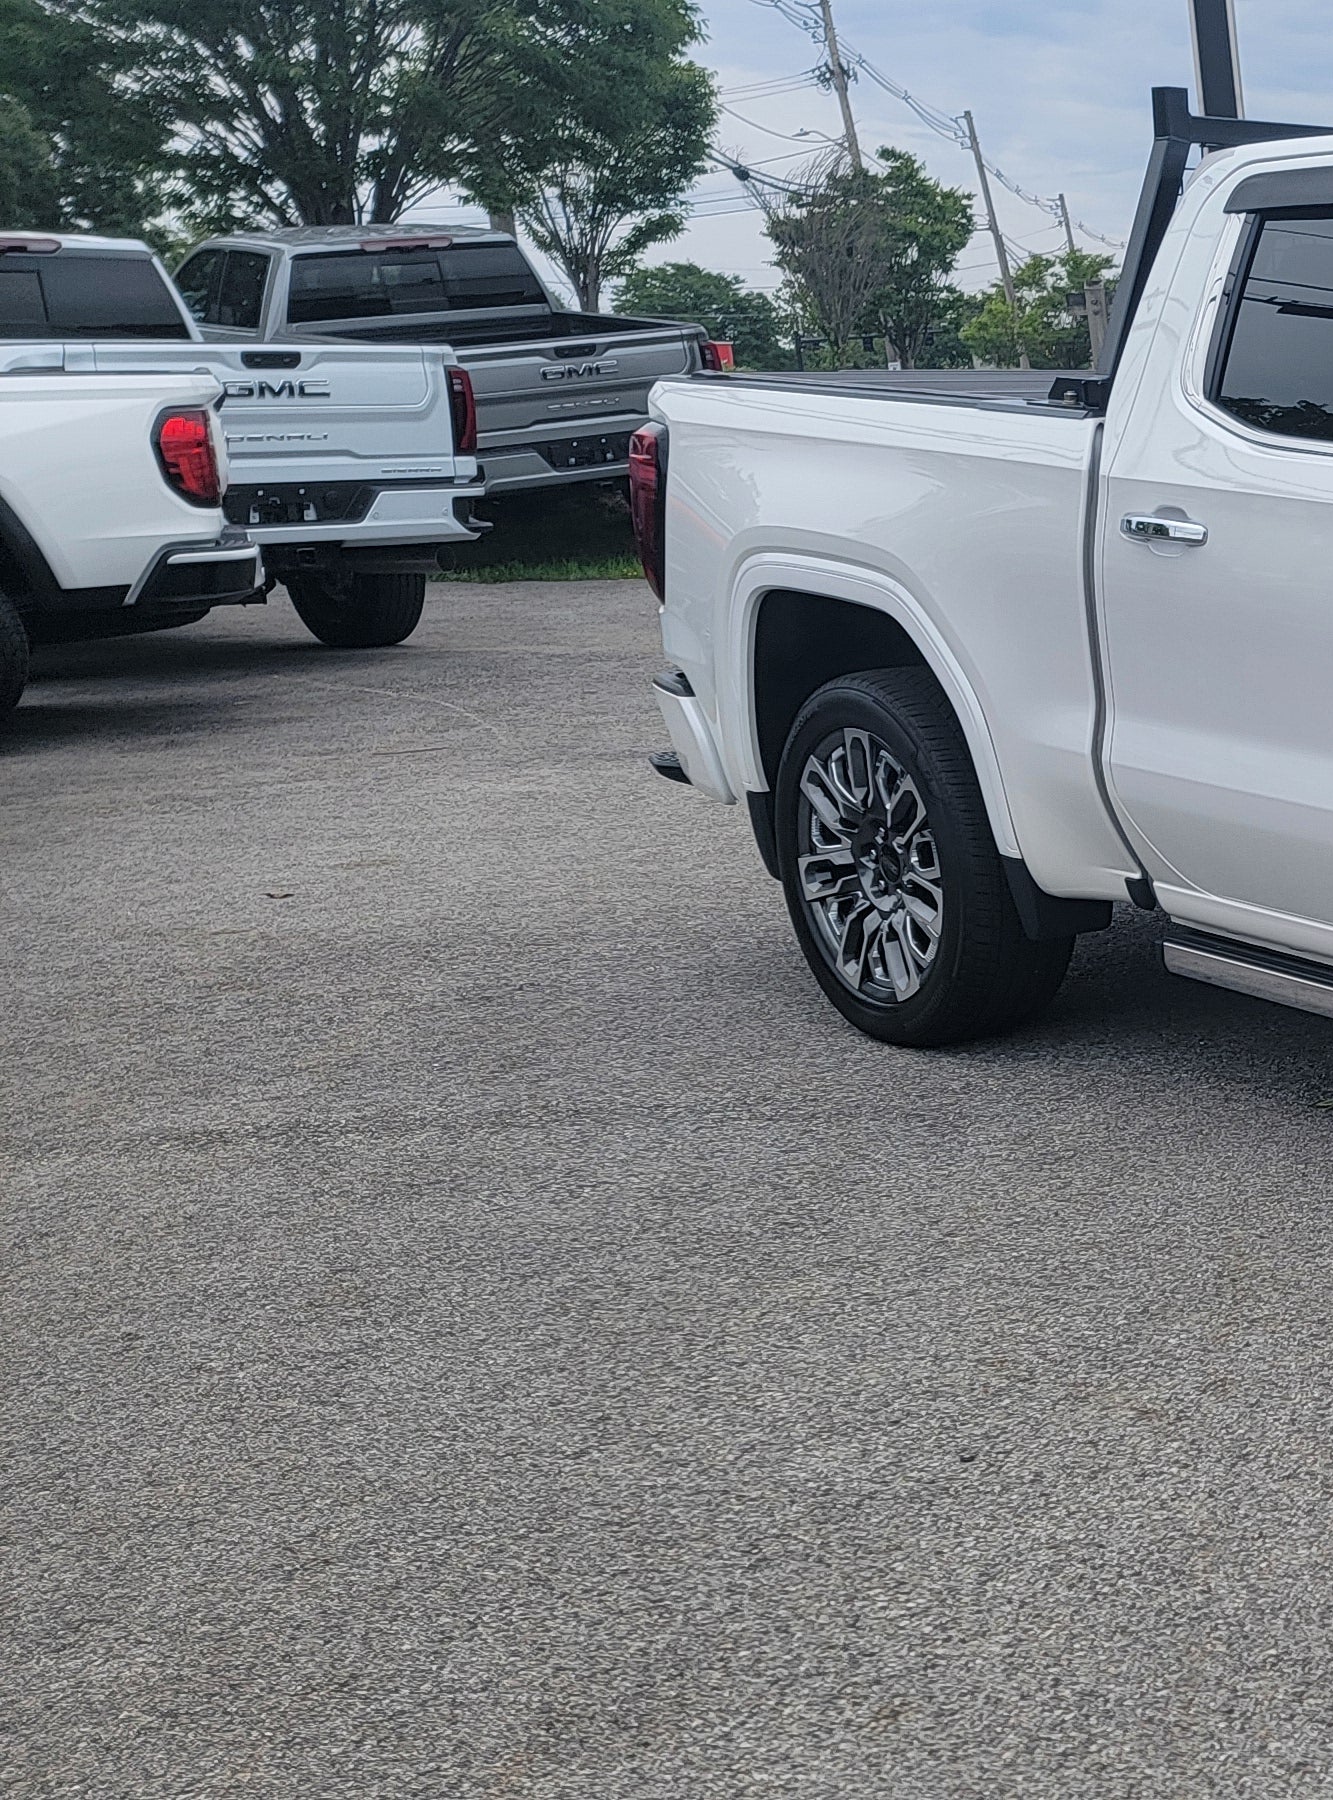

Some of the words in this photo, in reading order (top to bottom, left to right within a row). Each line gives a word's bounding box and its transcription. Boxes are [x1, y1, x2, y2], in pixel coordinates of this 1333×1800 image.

[540, 360, 619, 380] GMC
[222, 379, 330, 398] GMC
[226, 432, 328, 443] DENALI
